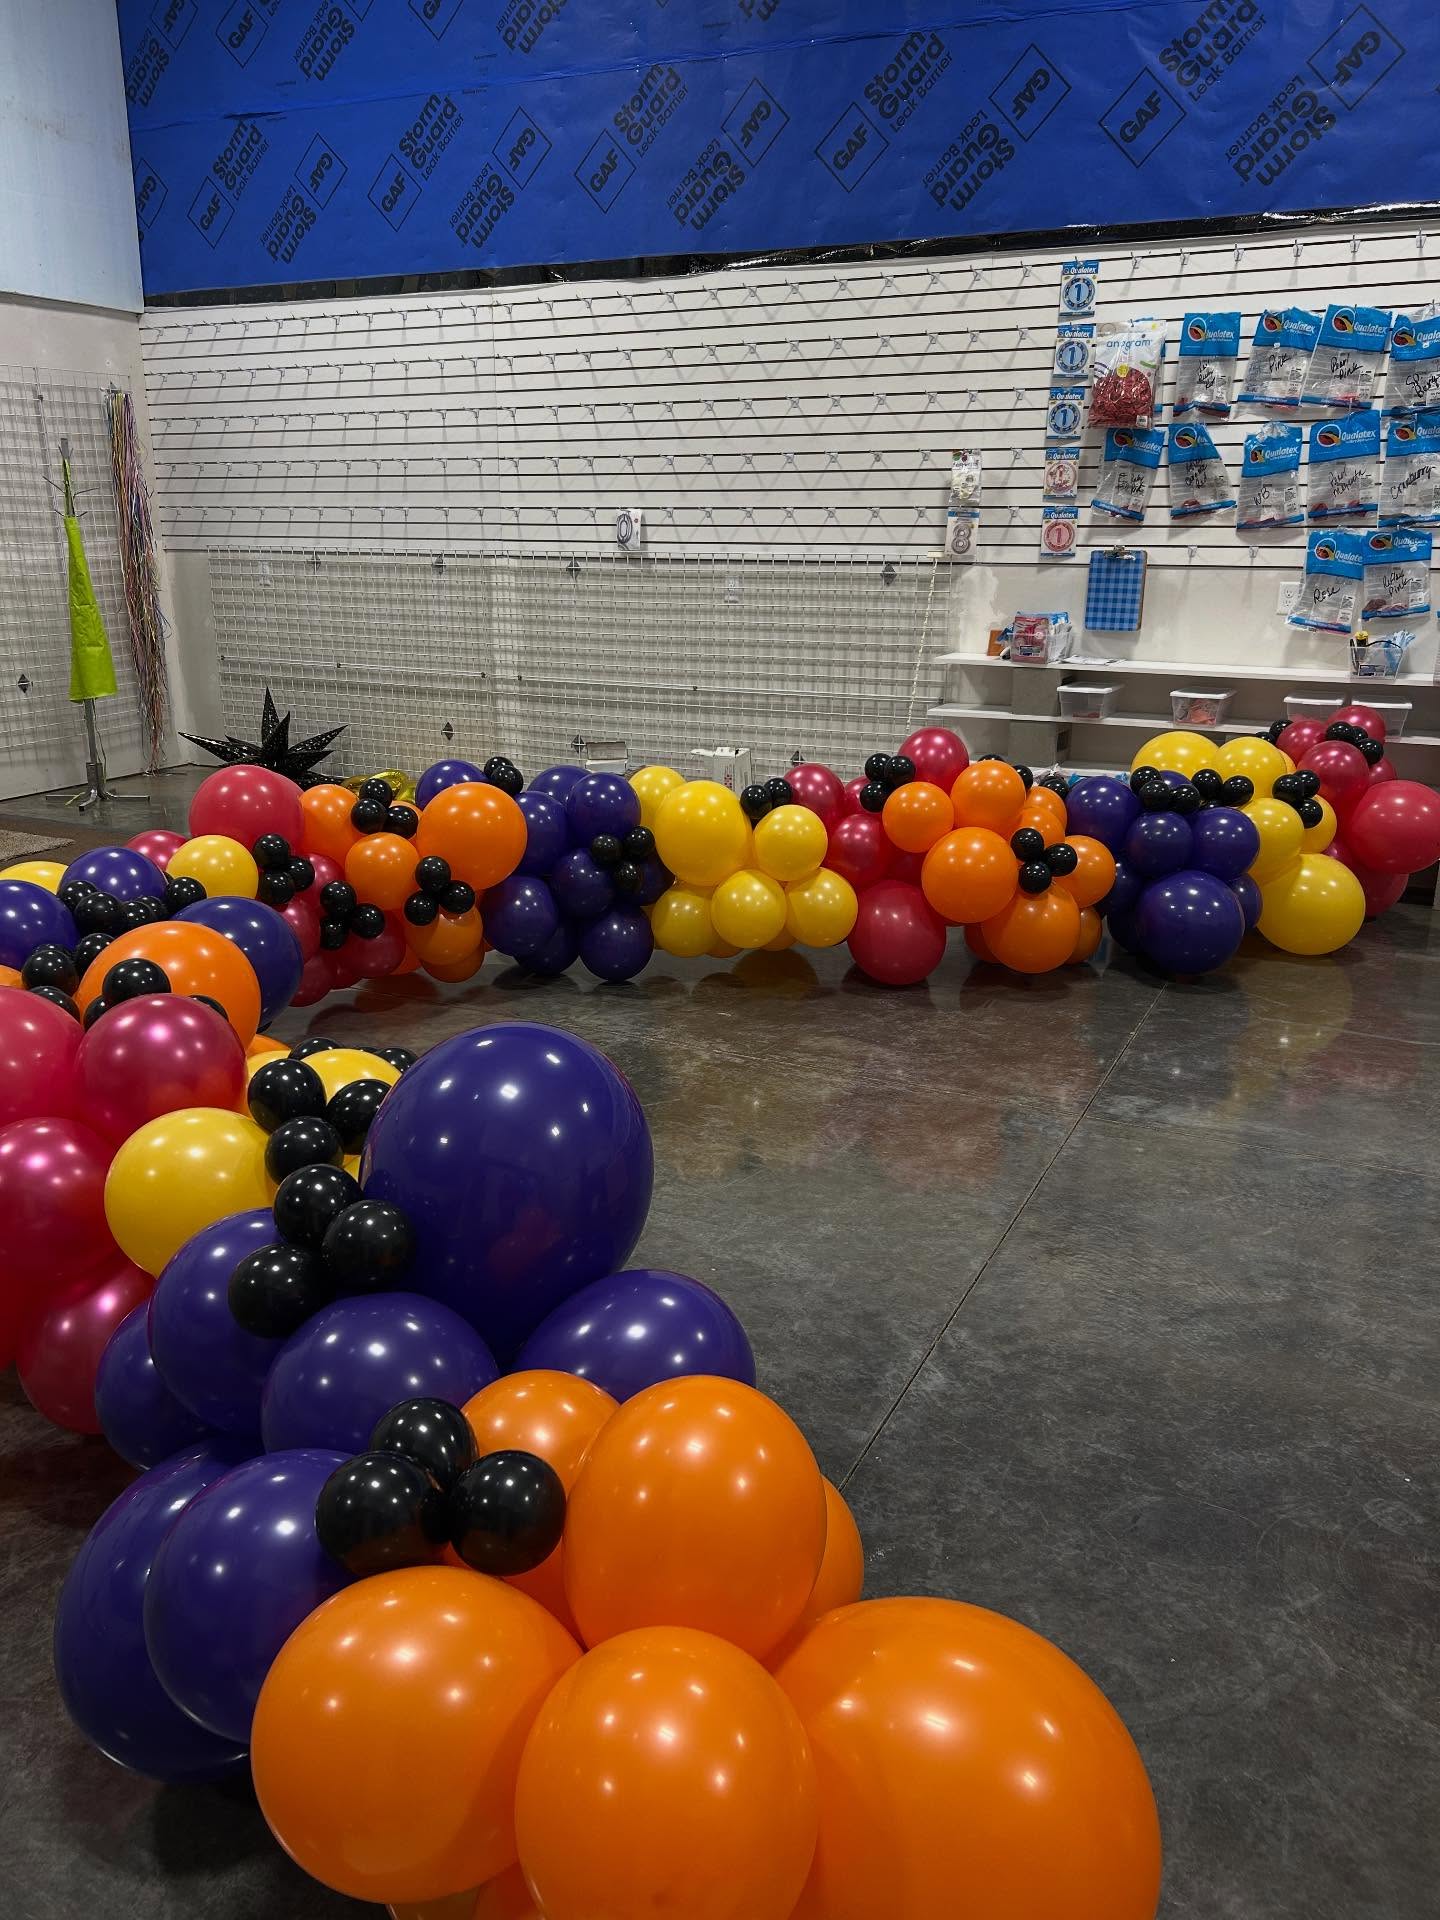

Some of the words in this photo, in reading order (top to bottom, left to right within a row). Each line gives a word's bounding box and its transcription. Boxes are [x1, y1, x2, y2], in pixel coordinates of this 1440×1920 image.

[228, 8, 253, 48] GAF
[300, 7, 343, 79] Guard
[314, 19, 354, 81] Storm
[1159, 0, 1232, 72] Storm
[1177, 0, 1258, 86] Guard
[126, 37, 160, 104] Guard
[140, 48, 169, 106] Storm
[864, 32, 925, 105] Storm
[880, 32, 945, 119] Guard
[1189, 65, 1224, 102] Leak
[1222, 14, 1267, 66] Barrier
[1335, 31, 1381, 85] GAF
[613, 65, 663, 132] Storm
[627, 67, 680, 145] Guard
[890, 99, 917, 133] Leak
[917, 50, 952, 98] Barrier
[1012, 68, 1050, 120] GAF
[1120, 90, 1161, 143] GAF
[1268, 75, 1305, 113] Leak
[399, 94, 440, 158] Storm
[412, 96, 457, 169] Guard
[421, 153, 440, 181] Leak
[437, 114, 464, 152] Barrier
[636, 127, 659, 158] Leak
[656, 85, 688, 127] Barrier
[741, 101, 771, 148] GAF
[833, 123, 867, 170] GAF
[959, 109, 988, 144] Leak
[1225, 112, 1270, 162] Barrier
[1233, 91, 1318, 182] Guard
[1256, 106, 1337, 186] Storm
[213, 120, 248, 180] Storm
[224, 124, 262, 190] Guard
[310, 153, 332, 193] GAF
[510, 128, 535, 171] GAF
[590, 148, 618, 192] GAF
[696, 138, 720, 169] Leak
[923, 143, 960, 188] Barrier
[930, 123, 999, 208] Guard
[950, 138, 1015, 211] Storm
[381, 171, 405, 213] GAF
[473, 162, 493, 192] Leak
[666, 169, 698, 209] Barrier
[674, 151, 732, 226] Guard
[690, 164, 745, 231] Storm
[200, 193, 220, 230] GAF
[267, 195, 304, 262] Guard
[281, 206, 316, 264] Storm
[449, 191, 475, 228] Barrier
[456, 174, 502, 244] Guard
[471, 186, 514, 248] Storm
[1070, 267, 1097, 275] Qualatex
[1074, 283, 1082, 302] 1
[1283, 319, 1316, 334] Qualatex
[1353, 321, 1388, 335] Qualatex
[1416, 329, 1440, 342] Quala
[1265, 446, 1299, 459] Qualatex
[1341, 429, 1376, 441] Qualatex
[1416, 426, 1440, 437] Quala
[1334, 550, 1363, 562] Qualate
[1313, 583, 1341, 605] Rose
